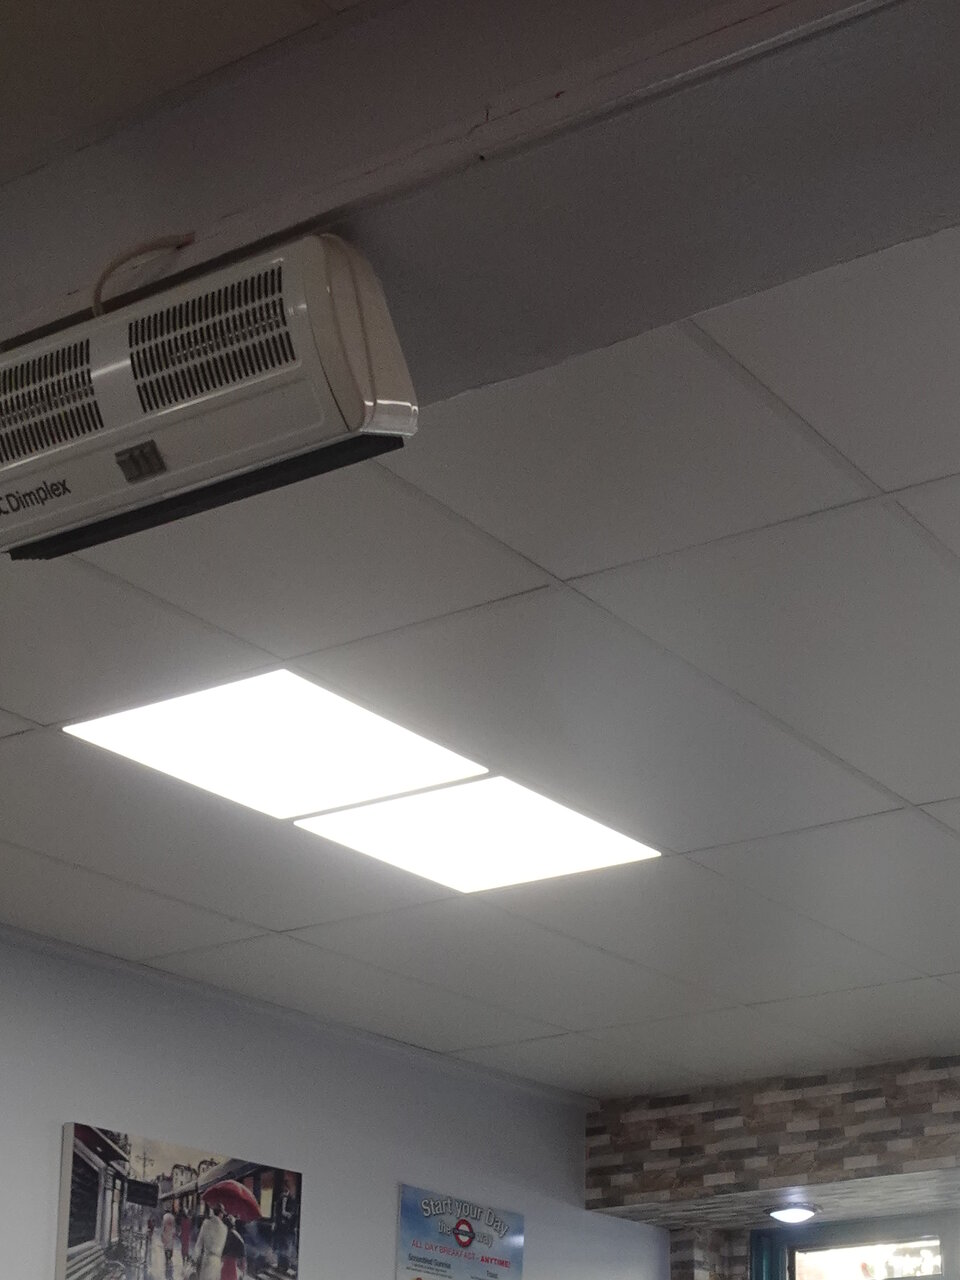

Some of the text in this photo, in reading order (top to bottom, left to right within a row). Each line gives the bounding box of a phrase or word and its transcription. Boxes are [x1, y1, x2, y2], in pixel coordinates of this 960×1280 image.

[5, 479, 72, 513] Dimplex
[421, 1198, 454, 1218] Start
[455, 1201, 484, 1221] your
[485, 1208, 511, 1239] Day
